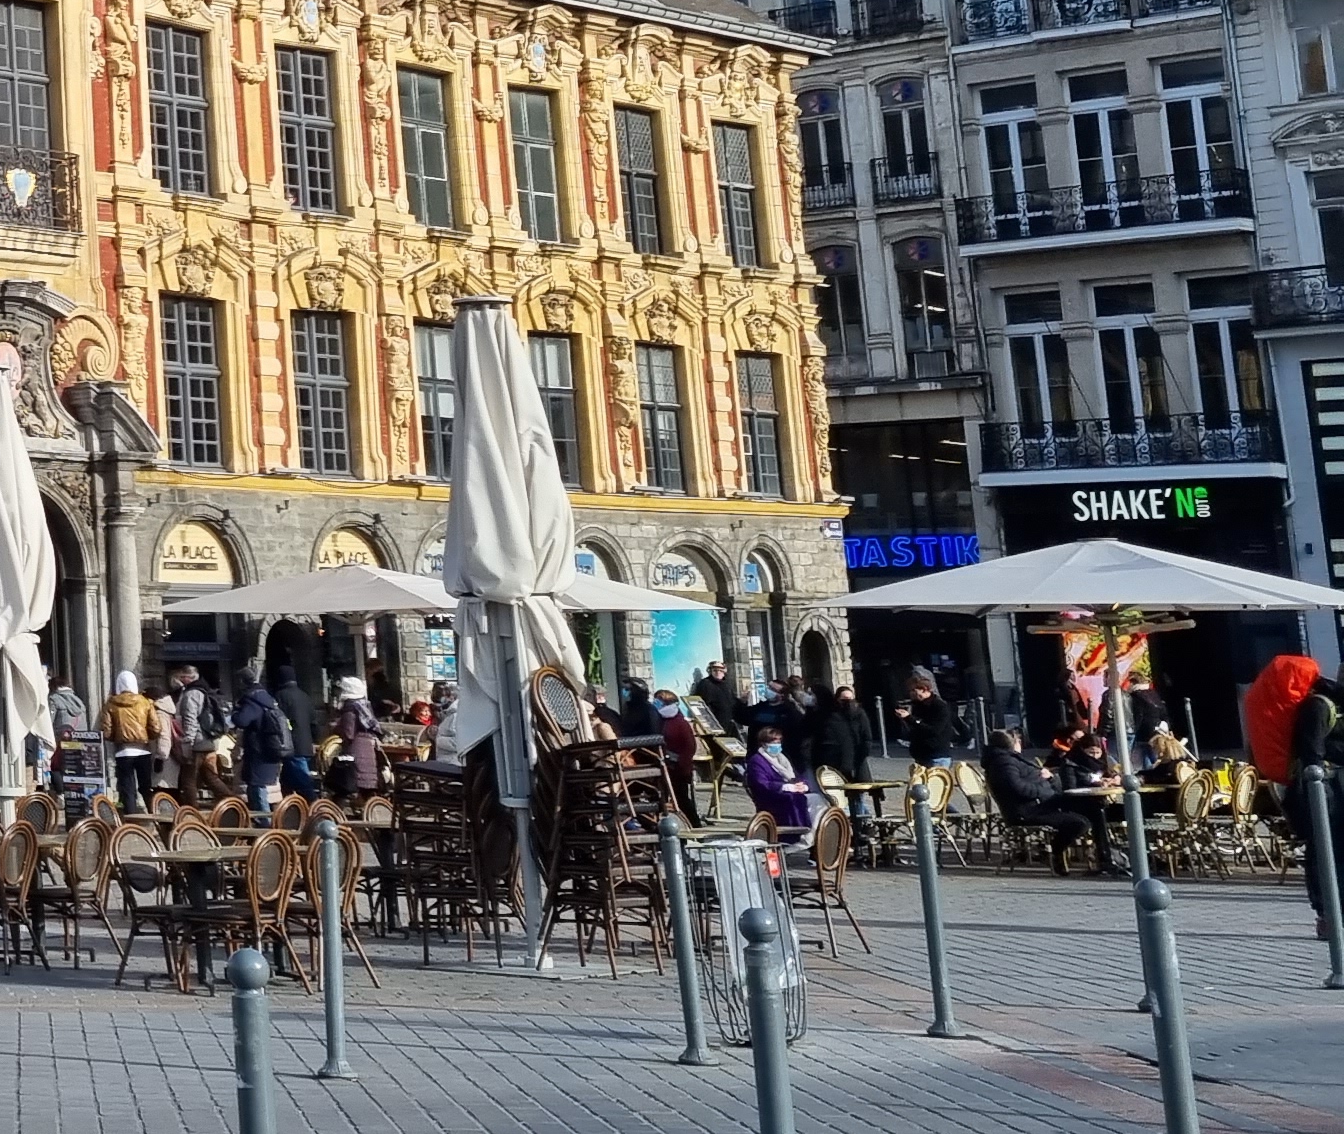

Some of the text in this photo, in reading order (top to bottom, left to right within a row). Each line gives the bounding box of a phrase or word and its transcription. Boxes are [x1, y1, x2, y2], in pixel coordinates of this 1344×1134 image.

[1072, 487, 1195, 522] SHAKE'N
[163, 545, 218, 560] LA PLACE
[318, 550, 369, 566] LA PLACE
